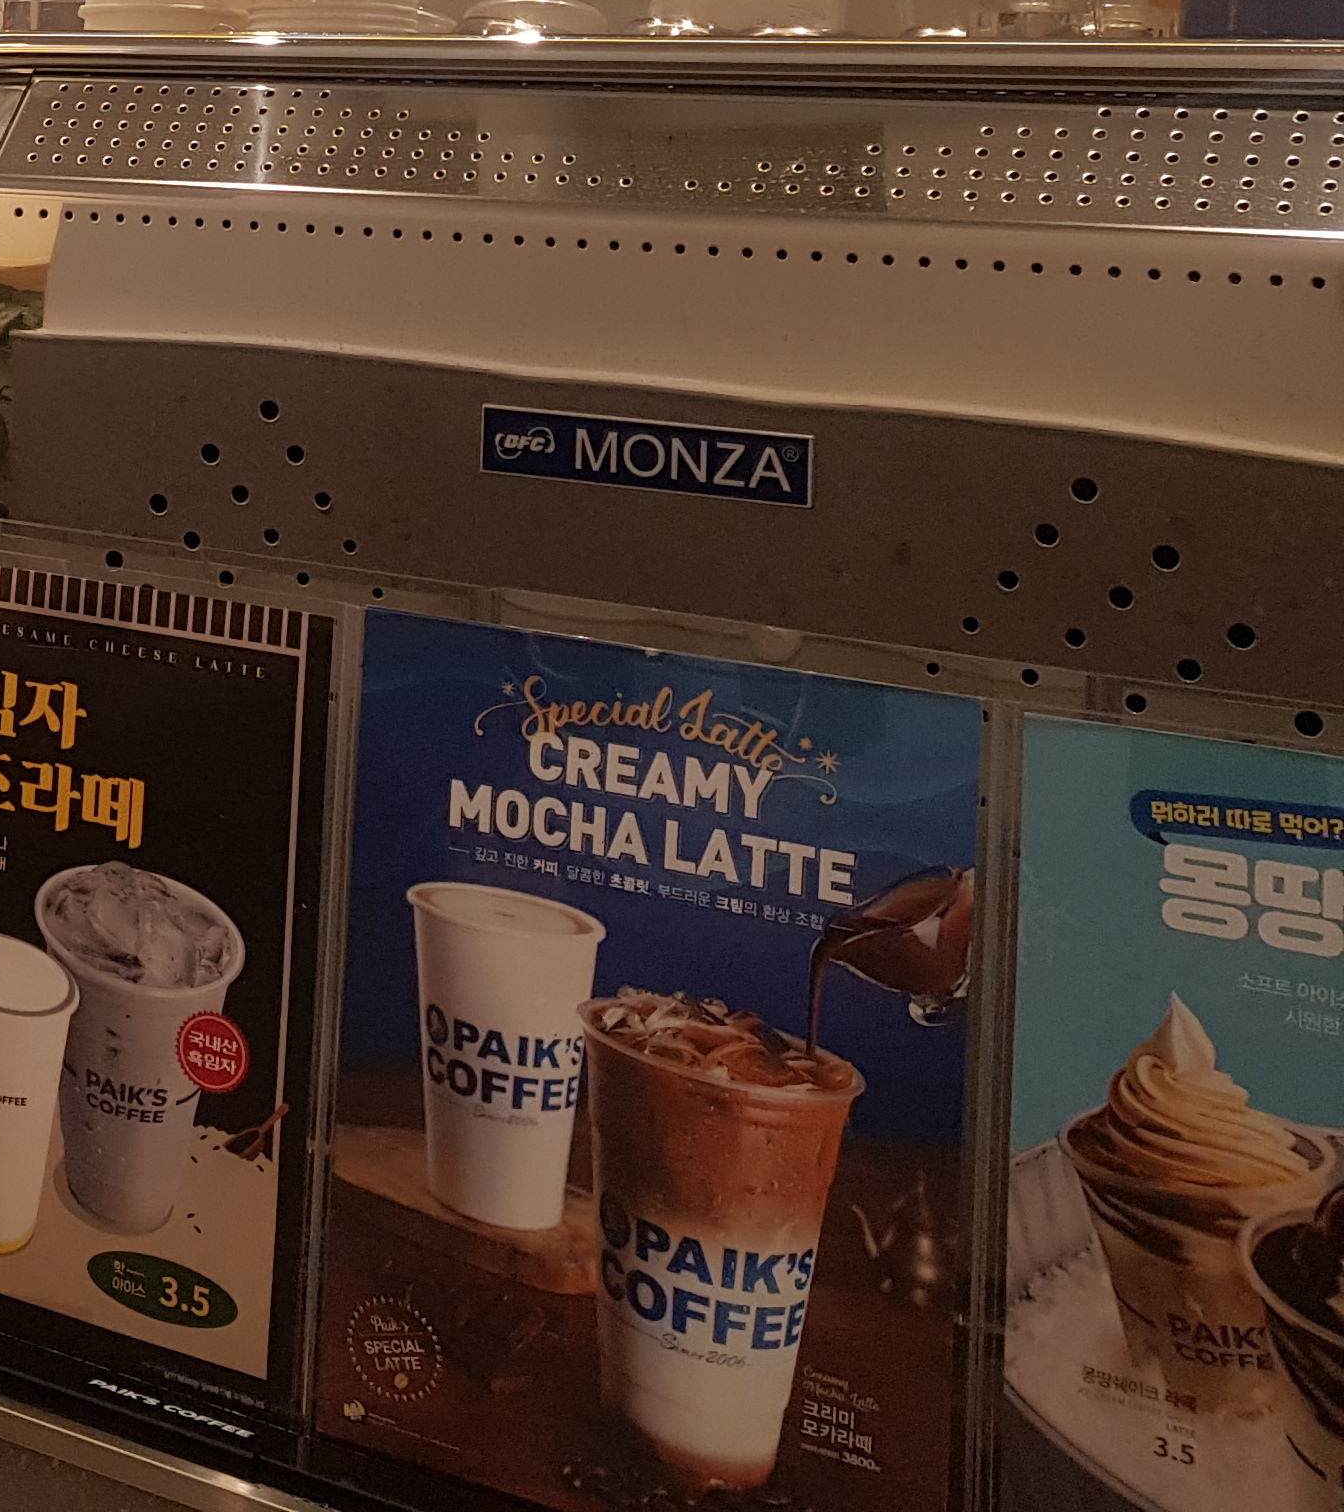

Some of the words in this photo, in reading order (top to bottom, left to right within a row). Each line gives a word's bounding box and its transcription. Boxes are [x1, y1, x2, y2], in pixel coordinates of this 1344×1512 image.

[575, 428, 791, 492] MONZA
[89, 638, 177, 663] CHEESE
[196, 656, 265, 679] LATTE
[522, 674, 673, 740] Special
[680, 689, 793, 773] Latte
[530, 733, 773, 819] CREAMY
[1151, 801, 1219, 827] 뭐하러
[1226, 809, 1272, 834] 따로
[449, 779, 649, 865] MOCHA
[664, 819, 856, 907] LATTE
[504, 852, 529, 870] 진한
[566, 865, 605, 885] 달콤한
[658, 884, 711, 906] 부드러운
[188, 1030, 239, 1056] 국내산
[187, 1050, 237, 1075] 흑임자
[426, 1046, 578, 1111] COFFEE
[85, 1069, 167, 1108] PAIK'S
[86, 1094, 164, 1124] COFFEE
[159, 1276, 210, 1317] 3.5
[603, 1251, 801, 1349] COFFEE
[364, 1340, 424, 1356] SPECIAL
[375, 1356, 421, 1371] LATTE
[163, 1403, 254, 1439] COFFEE
[802, 1400, 856, 1429] 크리미
[801, 1423, 874, 1453] 모카라떼
[1153, 1436, 1195, 1465] 3.5
